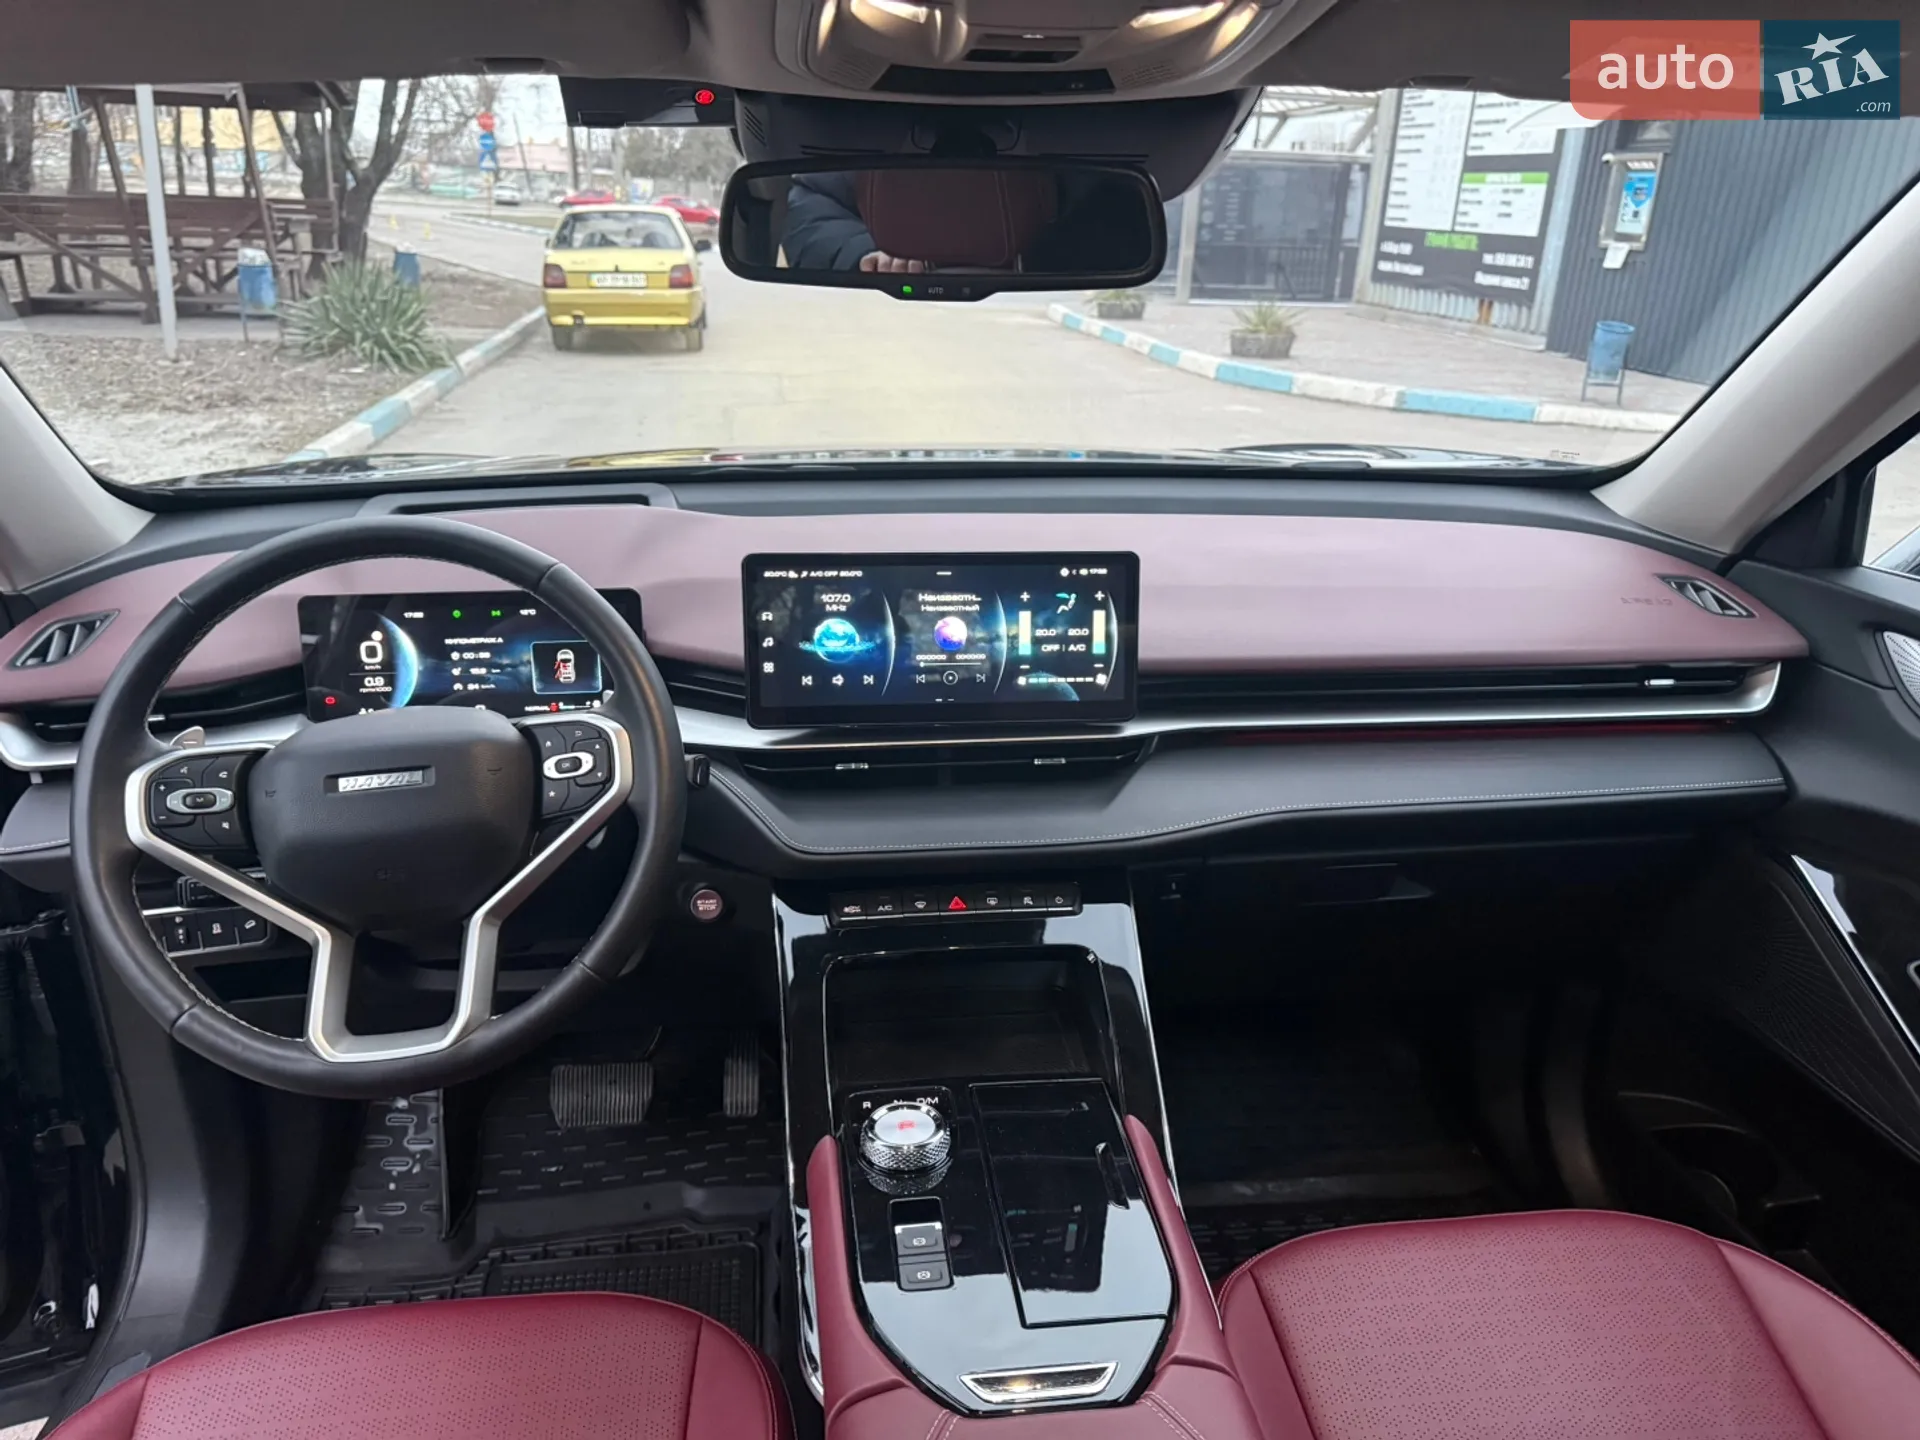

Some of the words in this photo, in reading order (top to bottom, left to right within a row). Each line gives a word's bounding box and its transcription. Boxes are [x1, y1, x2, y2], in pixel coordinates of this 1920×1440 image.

[927, 286, 944, 295] AUTO
[820, 593, 851, 603] 107.0
[825, 604, 847, 612] MHz
[1035, 628, 1056, 637] 20.0
[1067, 628, 1089, 636] 20.0
[1068, 643, 1087, 652] A/C
[364, 676, 385, 687] 0.9
[342, 771, 421, 790] HAVAL
[877, 904, 893, 912] A/C
[862, 1101, 871, 1109] R
